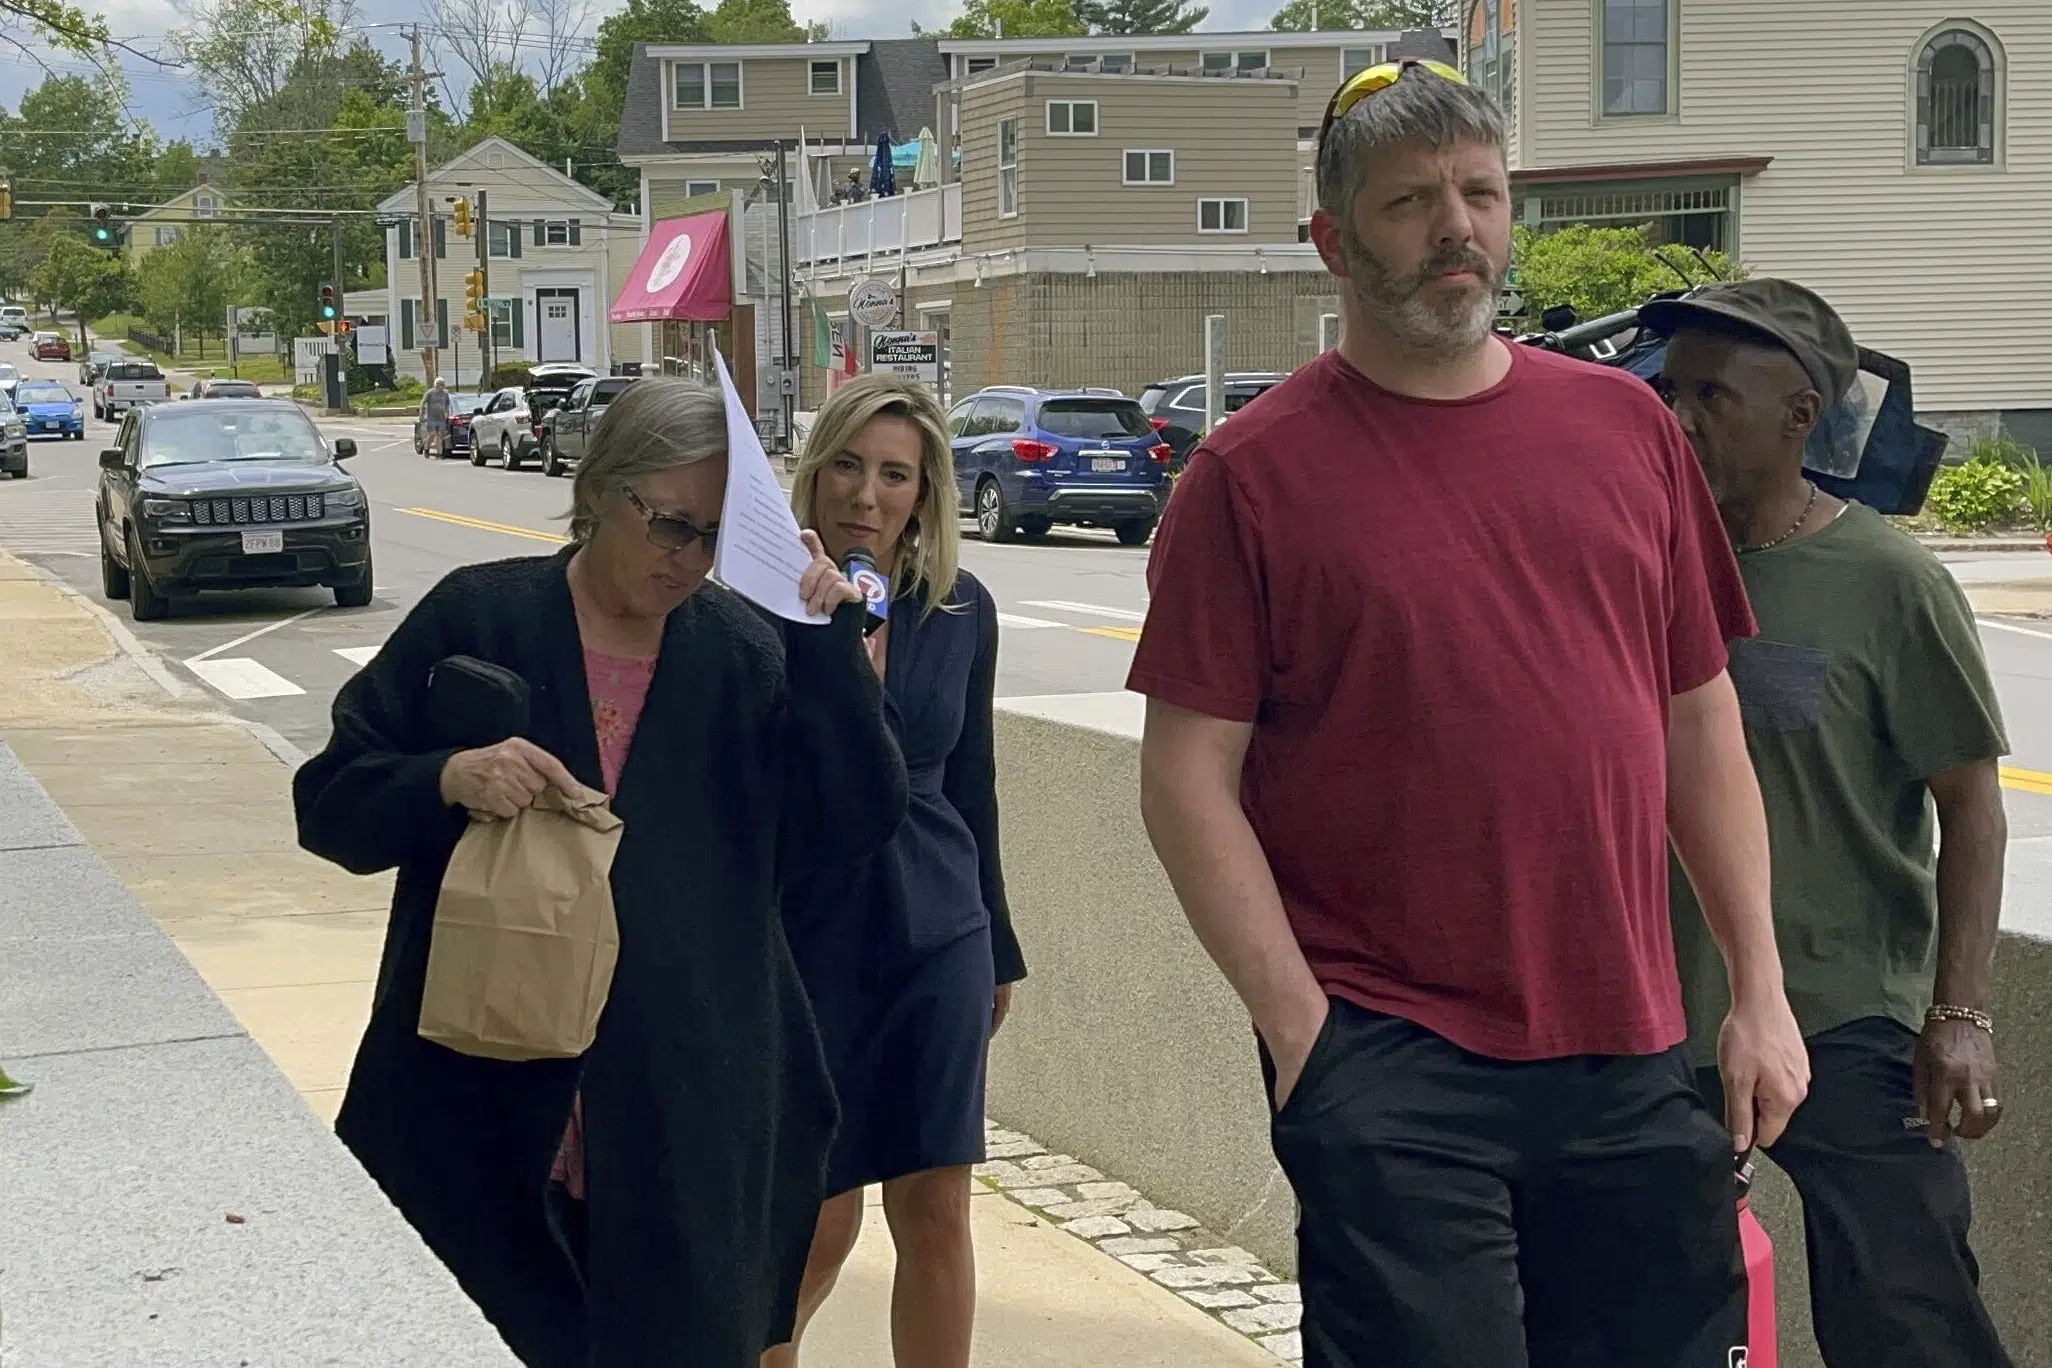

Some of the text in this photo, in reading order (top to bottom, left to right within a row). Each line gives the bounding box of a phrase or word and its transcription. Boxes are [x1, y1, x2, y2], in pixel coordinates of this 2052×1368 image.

[873, 333, 917, 348] Nonna's
[888, 346, 921, 354] ITALIAN
[876, 353, 932, 362] RESTAURANT
